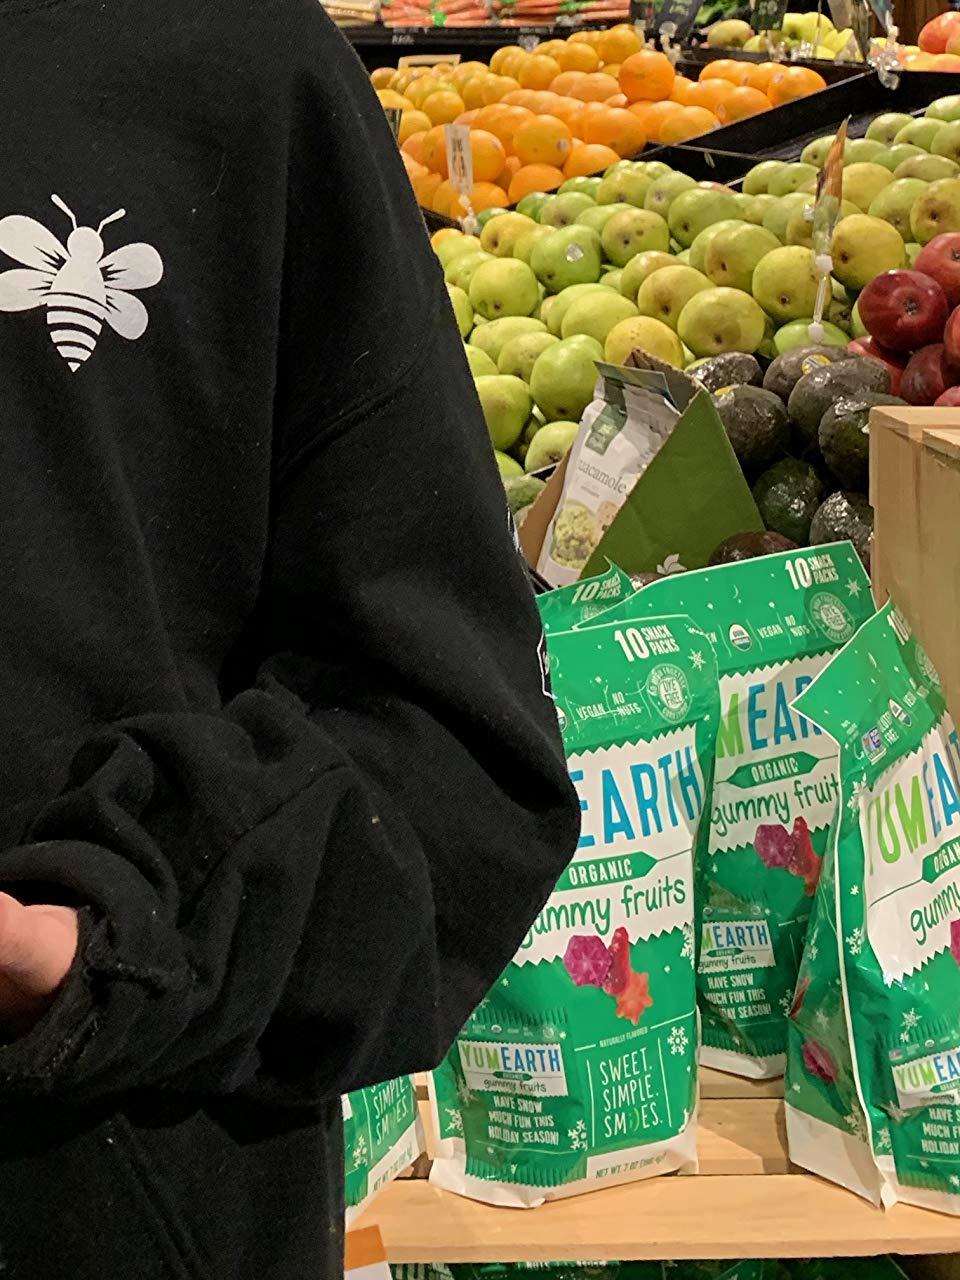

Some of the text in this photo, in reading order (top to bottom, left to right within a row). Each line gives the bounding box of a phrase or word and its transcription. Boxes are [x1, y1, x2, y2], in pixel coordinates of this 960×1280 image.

[578, 460, 627, 494] uacamole
[807, 554, 835, 570] SNACK
[600, 572, 622, 591] SNACK
[785, 557, 813, 590] 10
[813, 568, 839, 584] PACKS
[571, 581, 600, 604] 10
[596, 584, 622, 600] PACKS
[784, 615, 796, 626] NO
[641, 624, 672, 641] SNACK
[757, 624, 784, 639] VEGAN
[790, 624, 811, 638] NUTS
[614, 627, 650, 662] 10
[649, 638, 680, 656] PACKS
[612, 691, 626, 704] NO
[576, 703, 607, 720] VEGAN
[616, 703, 642, 717] NUTS
[717, 675, 822, 758] MEAR
[751, 757, 799, 782] ORGANIC
[569, 745, 702, 849] EARTH
[711, 773, 839, 837] gummy fruit
[933, 839, 960, 873] ORGAN
[568, 858, 633, 886] ORGANIC
[621, 875, 686, 918] fruits
[703, 924, 769, 950] MEARTH
[707, 973, 754, 990] HAVE SNOW
[729, 990, 745, 1004] FUN
[746, 988, 766, 1002] THIS
[737, 1003, 772, 1019] SEASON!
[461, 1044, 561, 1072] YUMEARTH
[599, 1047, 653, 1086] SWEET.
[896, 1050, 960, 1091] YUMEA
[483, 1079, 547, 1093] gummy fruits
[603, 1073, 659, 1112] SIMPLE.
[493, 1095, 542, 1113] HAVE SNOW
[488, 1111, 555, 1129] MUCH FUN THIS
[928, 1107, 953, 1122] HAVE
[488, 1125, 559, 1146] HOLIDAY SEASON!
[922, 1122, 951, 1138] MUCH
[922, 1139, 959, 1155] HOLIDAY
